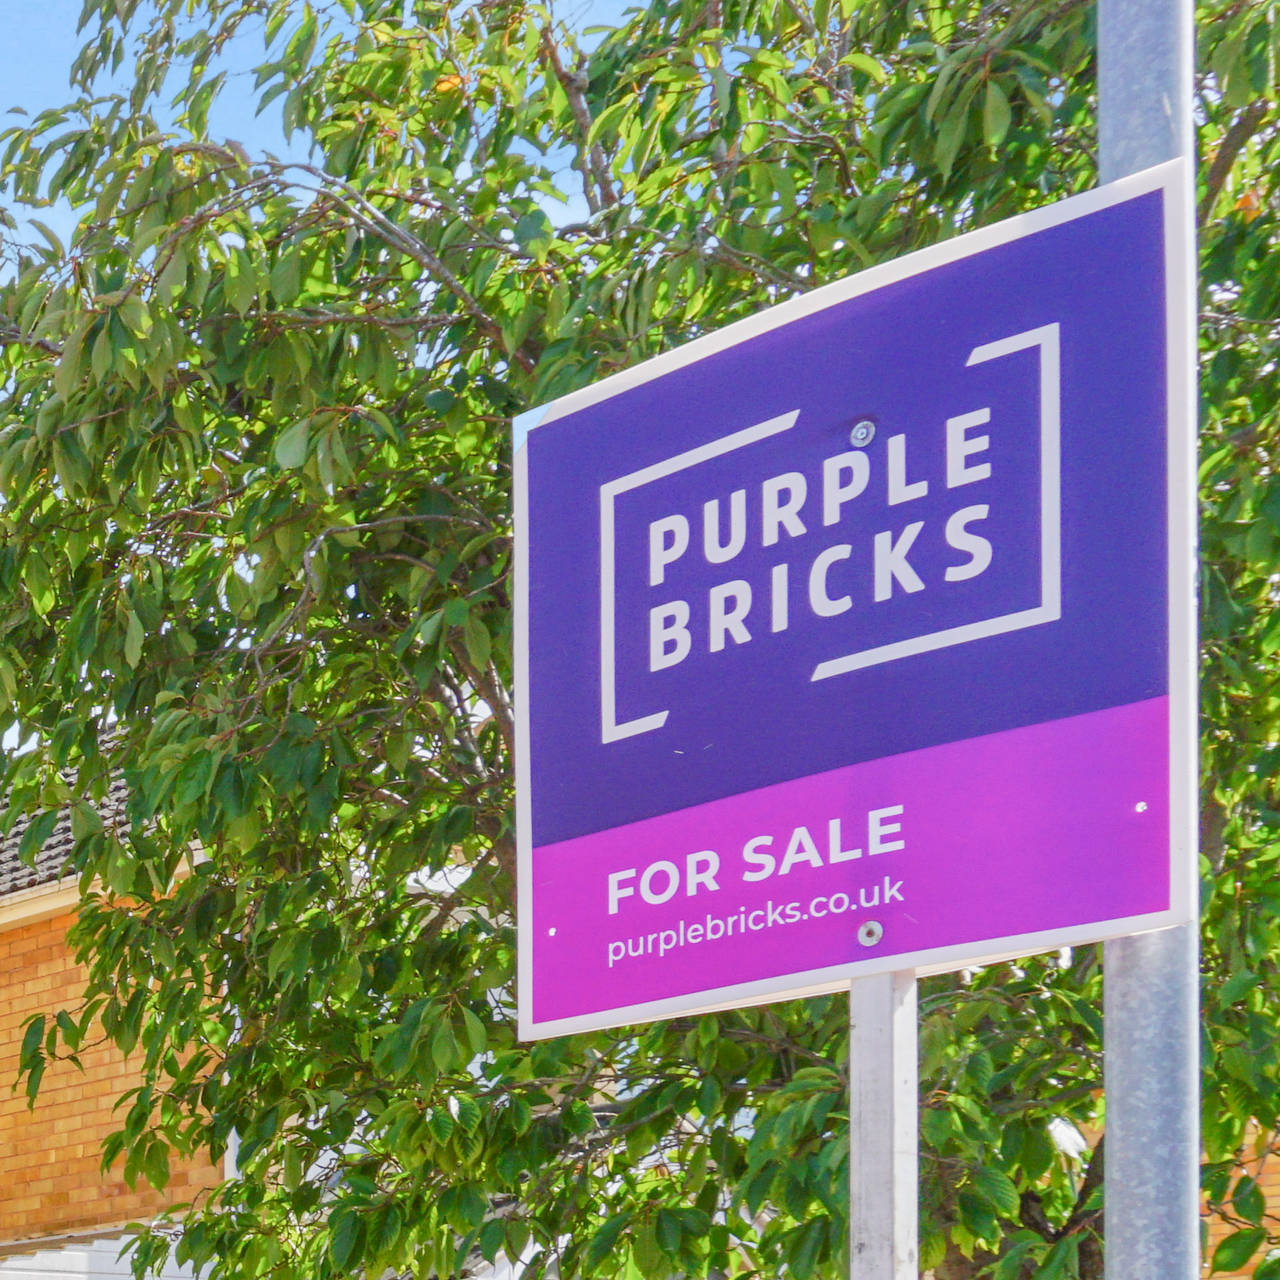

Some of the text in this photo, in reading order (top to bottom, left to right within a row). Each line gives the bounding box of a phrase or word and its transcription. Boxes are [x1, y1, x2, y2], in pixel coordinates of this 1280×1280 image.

[648, 406, 992, 587] PURPLE
[648, 503, 995, 674] BRICKS
[607, 804, 906, 916] FOR SALE
[607, 875, 905, 969] purplebricks.co.uk
